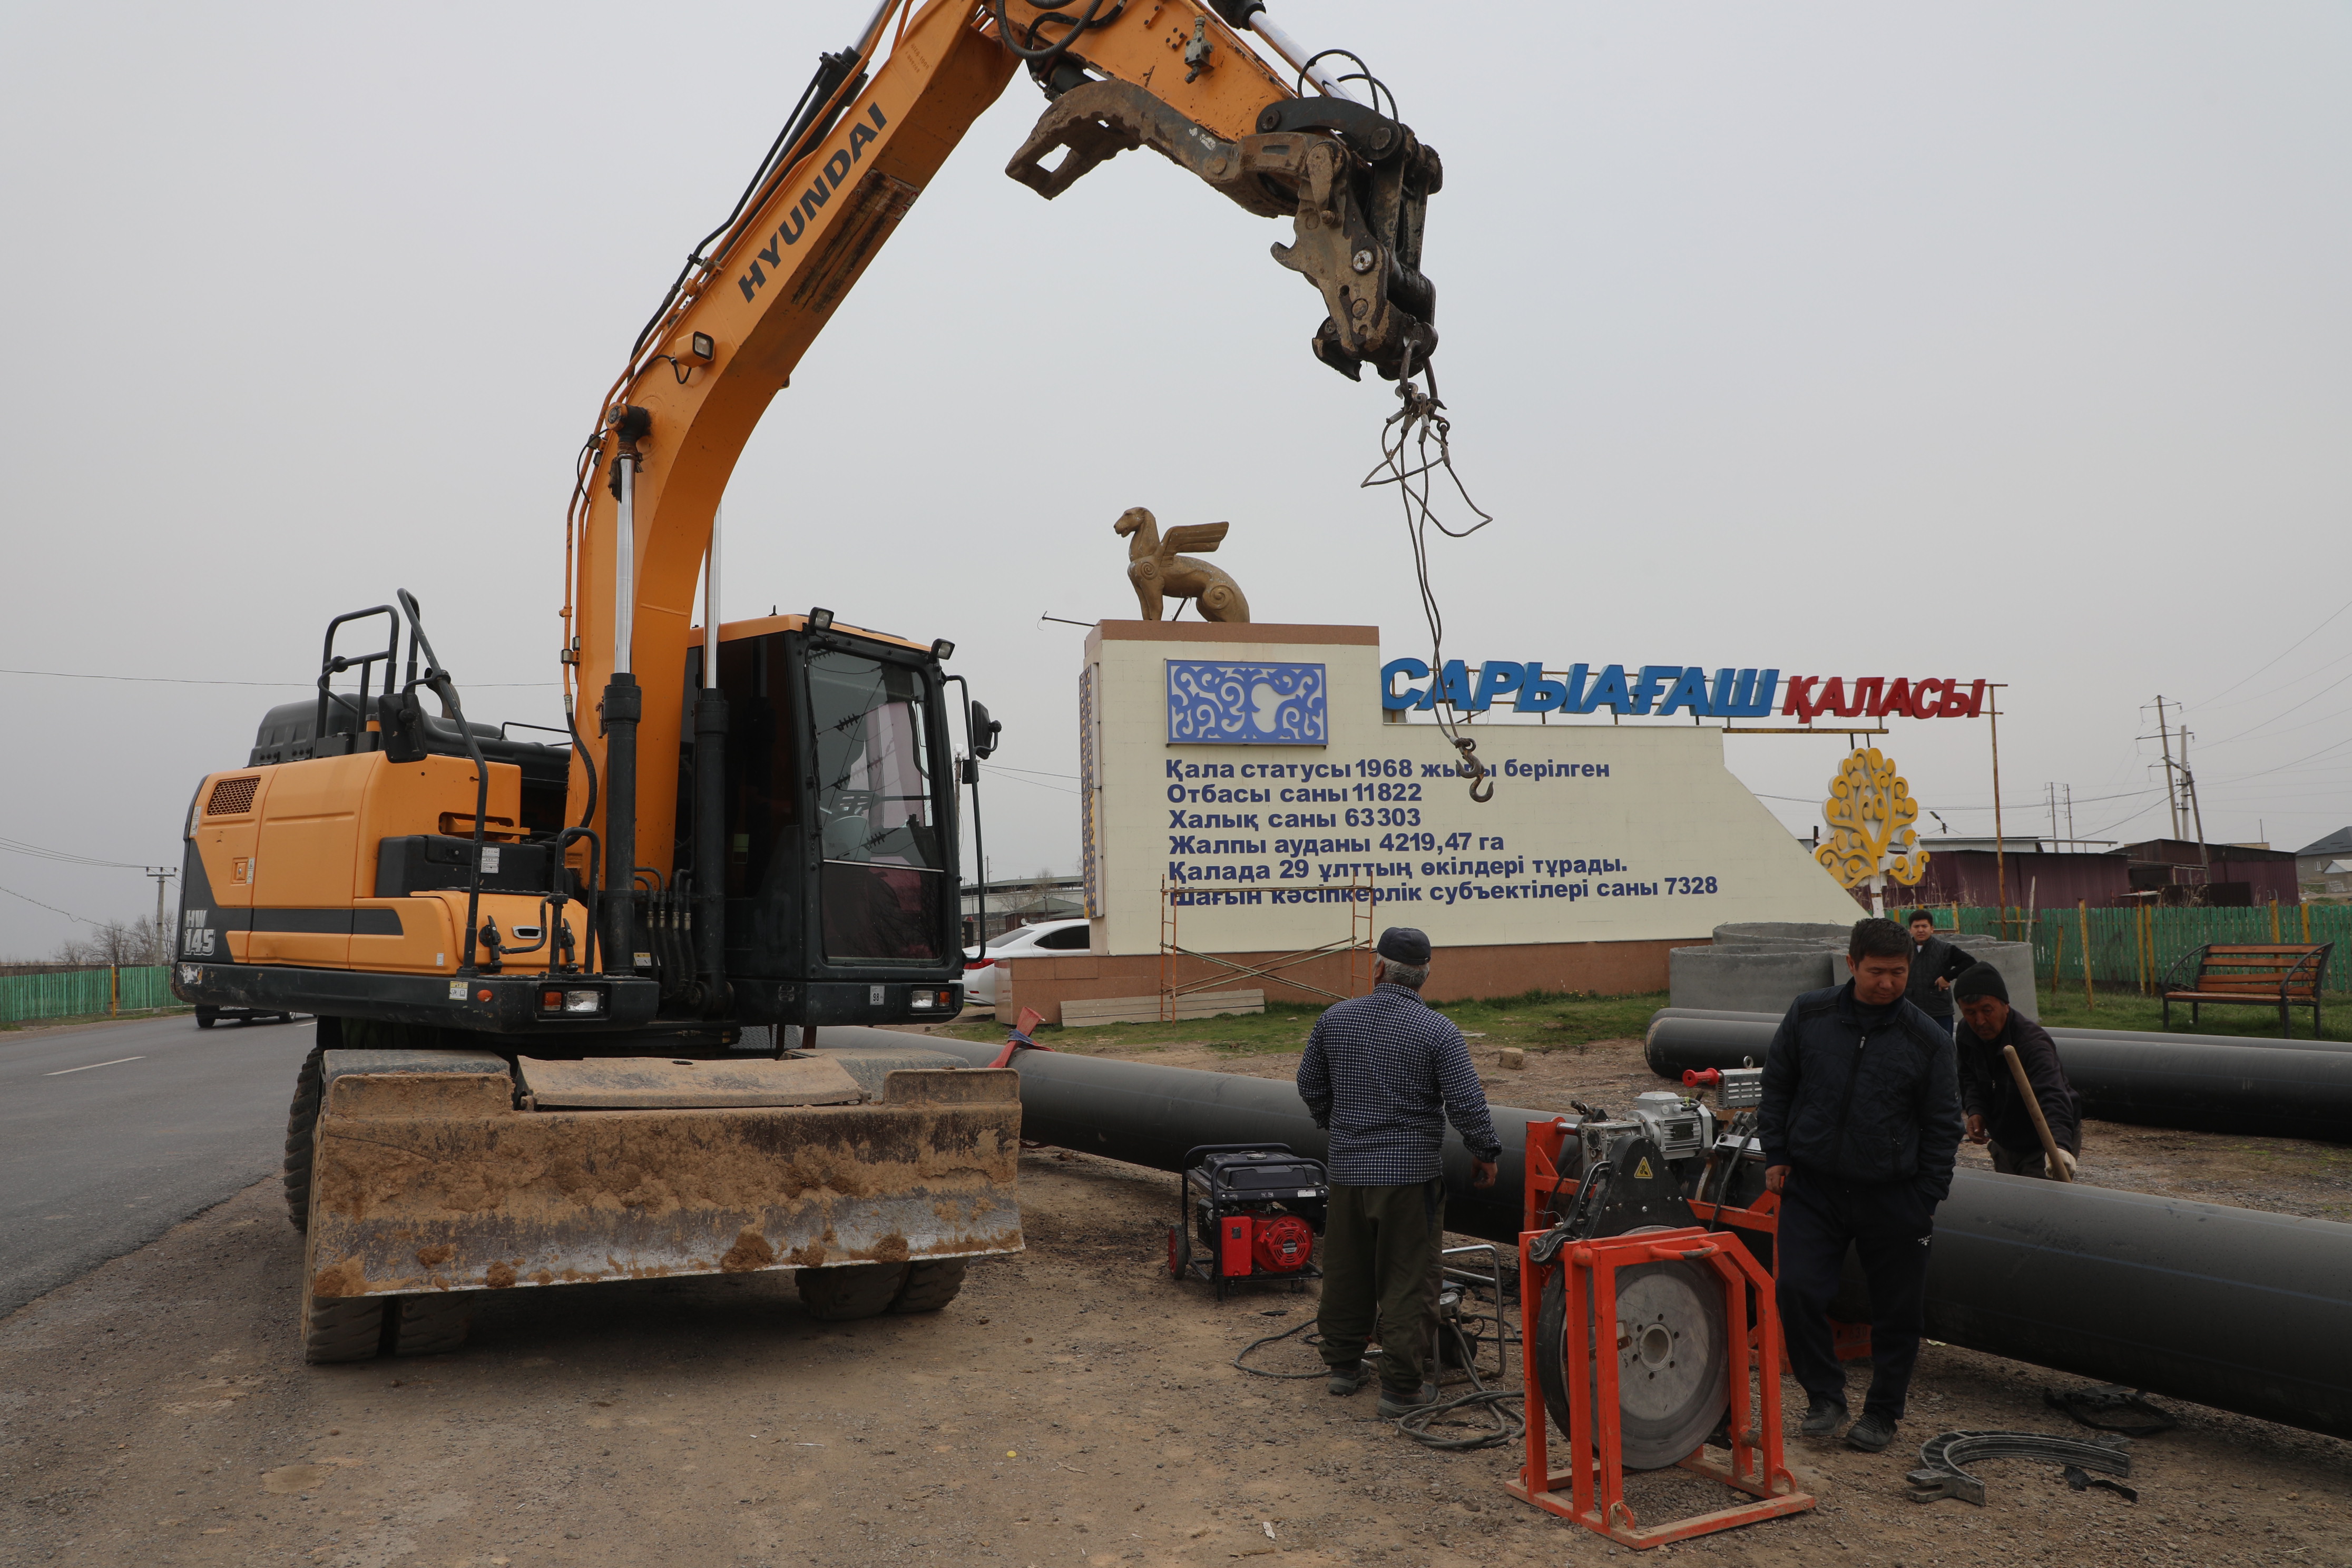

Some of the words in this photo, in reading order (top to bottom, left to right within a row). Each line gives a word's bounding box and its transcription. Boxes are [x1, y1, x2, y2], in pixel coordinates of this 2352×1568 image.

[738, 102, 887, 303] HYUNDAI
[1380, 658, 1780, 718] САРЫАҒАШ
[1781, 675, 1986, 724] ҚАЛАСЫ
[1166, 759, 1234, 781] Қала
[1241, 764, 1350, 782] статусы
[1356, 759, 1412, 777] 1968
[1505, 759, 1609, 781] берілген
[1167, 783, 1270, 802] Отбасы
[1280, 788, 1347, 801] саны
[1352, 782, 1422, 801] 11822
[1169, 810, 1258, 830] Халық
[1268, 814, 1336, 827] саны
[1169, 835, 1266, 854] Жалпы
[1275, 838, 1370, 857] ауданы
[1379, 832, 1472, 854] 4219,47
[1479, 837, 1503, 849] га
[1169, 861, 1270, 883] Қалада
[1280, 859, 1309, 878] 29
[1318, 862, 1412, 881] ұлттың
[1421, 855, 1524, 877] өкілдері
[1532, 858, 1626, 877] тұрады.
[1430, 879, 1588, 904] субъектілері
[1597, 883, 1658, 896] саны
[1664, 876, 1718, 894] 7328
[186, 910, 208, 927] HW
[184, 929, 215, 955] 145
[873, 993, 879, 1002] 98
